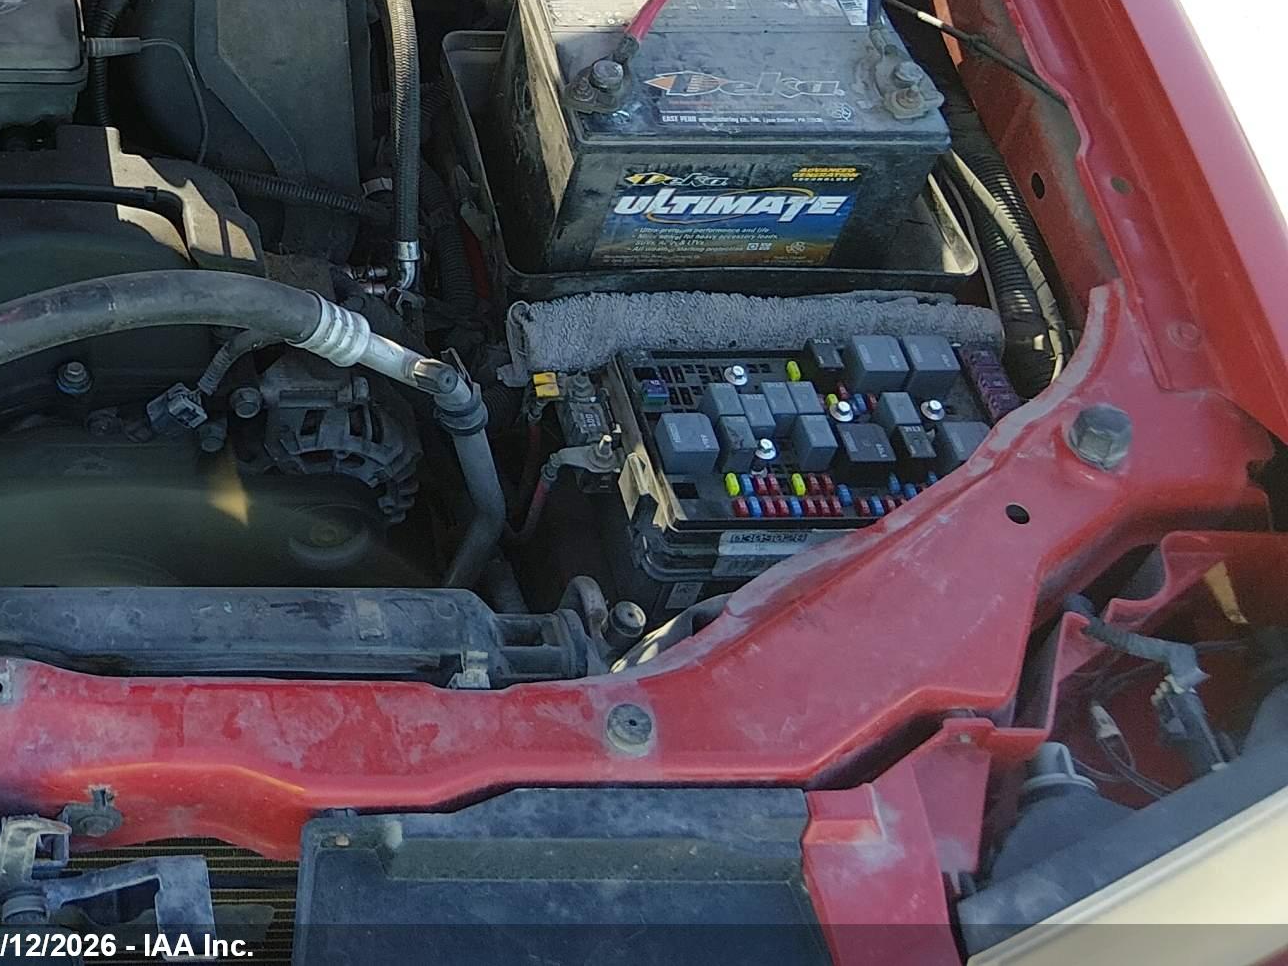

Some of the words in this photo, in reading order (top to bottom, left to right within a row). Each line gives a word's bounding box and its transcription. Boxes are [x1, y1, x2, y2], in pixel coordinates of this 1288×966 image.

[645, 71, 840, 98] Deka
[625, 172, 726, 188] Deka
[614, 187, 849, 223] ULTIMATE
